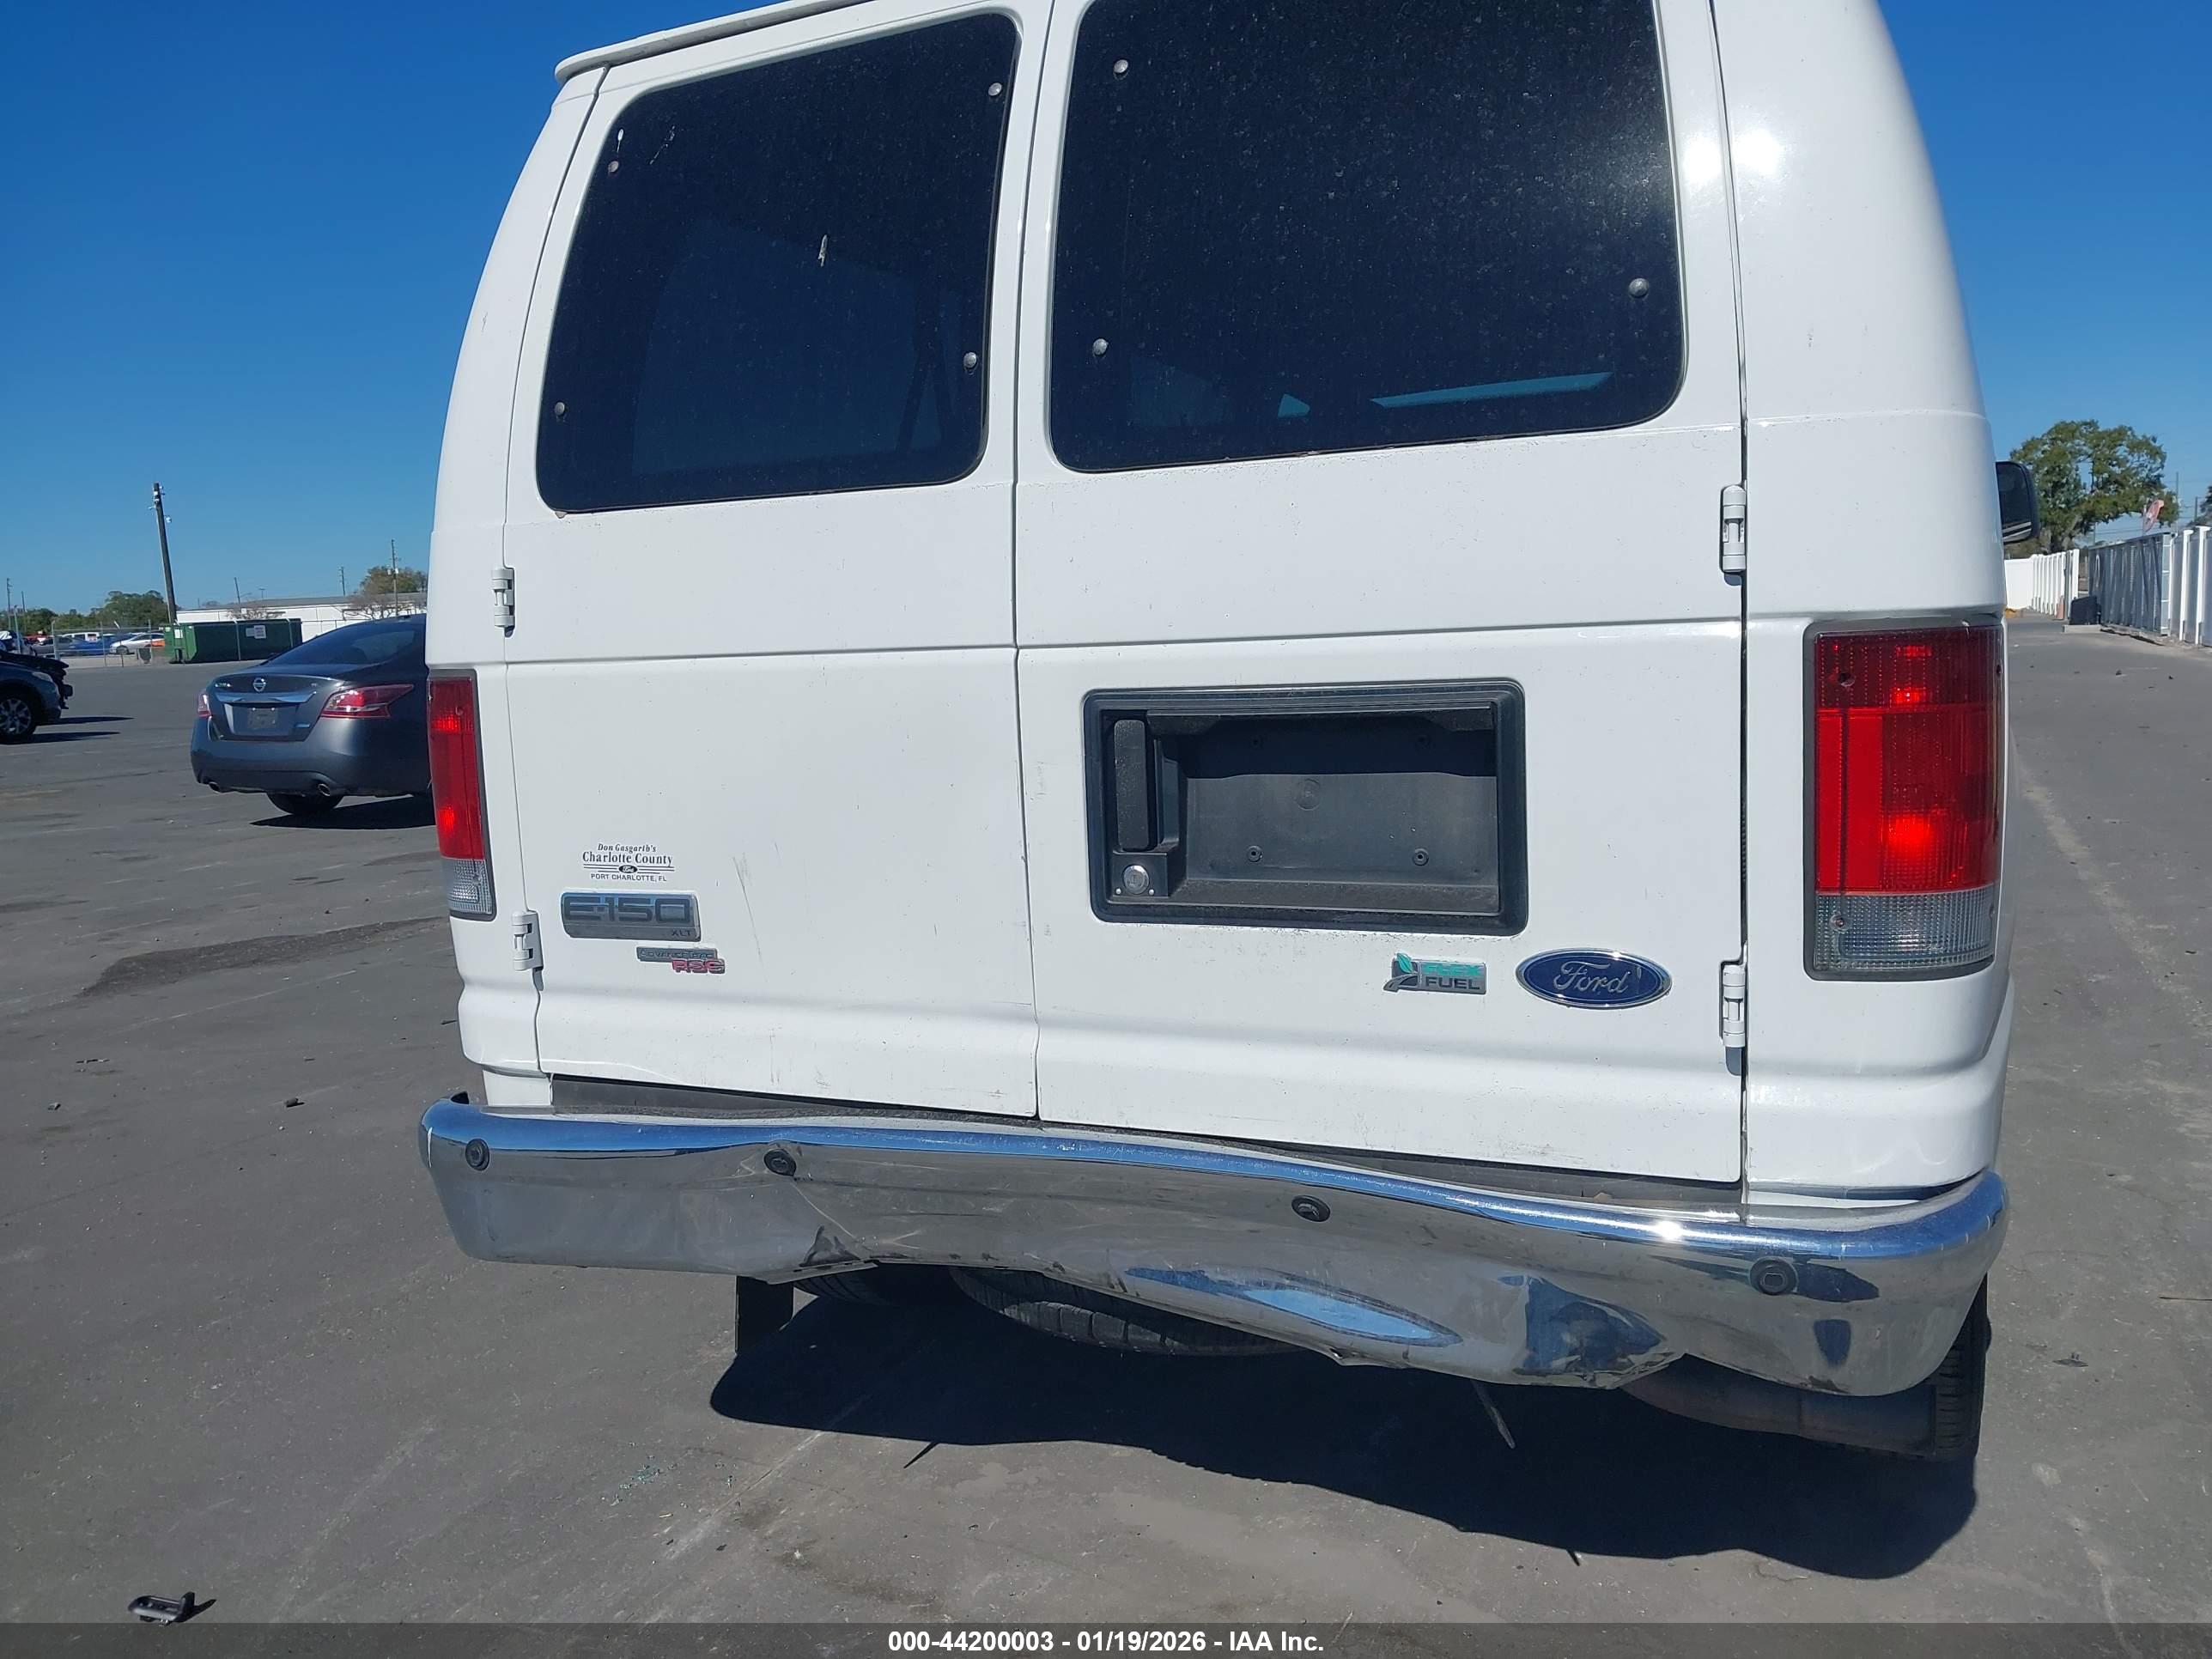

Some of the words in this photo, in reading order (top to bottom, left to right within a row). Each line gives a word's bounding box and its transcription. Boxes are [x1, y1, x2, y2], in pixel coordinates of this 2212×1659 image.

[582, 851, 632, 864] Charlotte
[635, 853, 673, 867] County
[611, 873, 657, 882] CHARLOTTE,
[672, 929, 692, 938] XLT
[672, 958, 726, 974] RSC
[1425, 976, 1480, 990] FUEL
[1553, 960, 1632, 993] Ford
